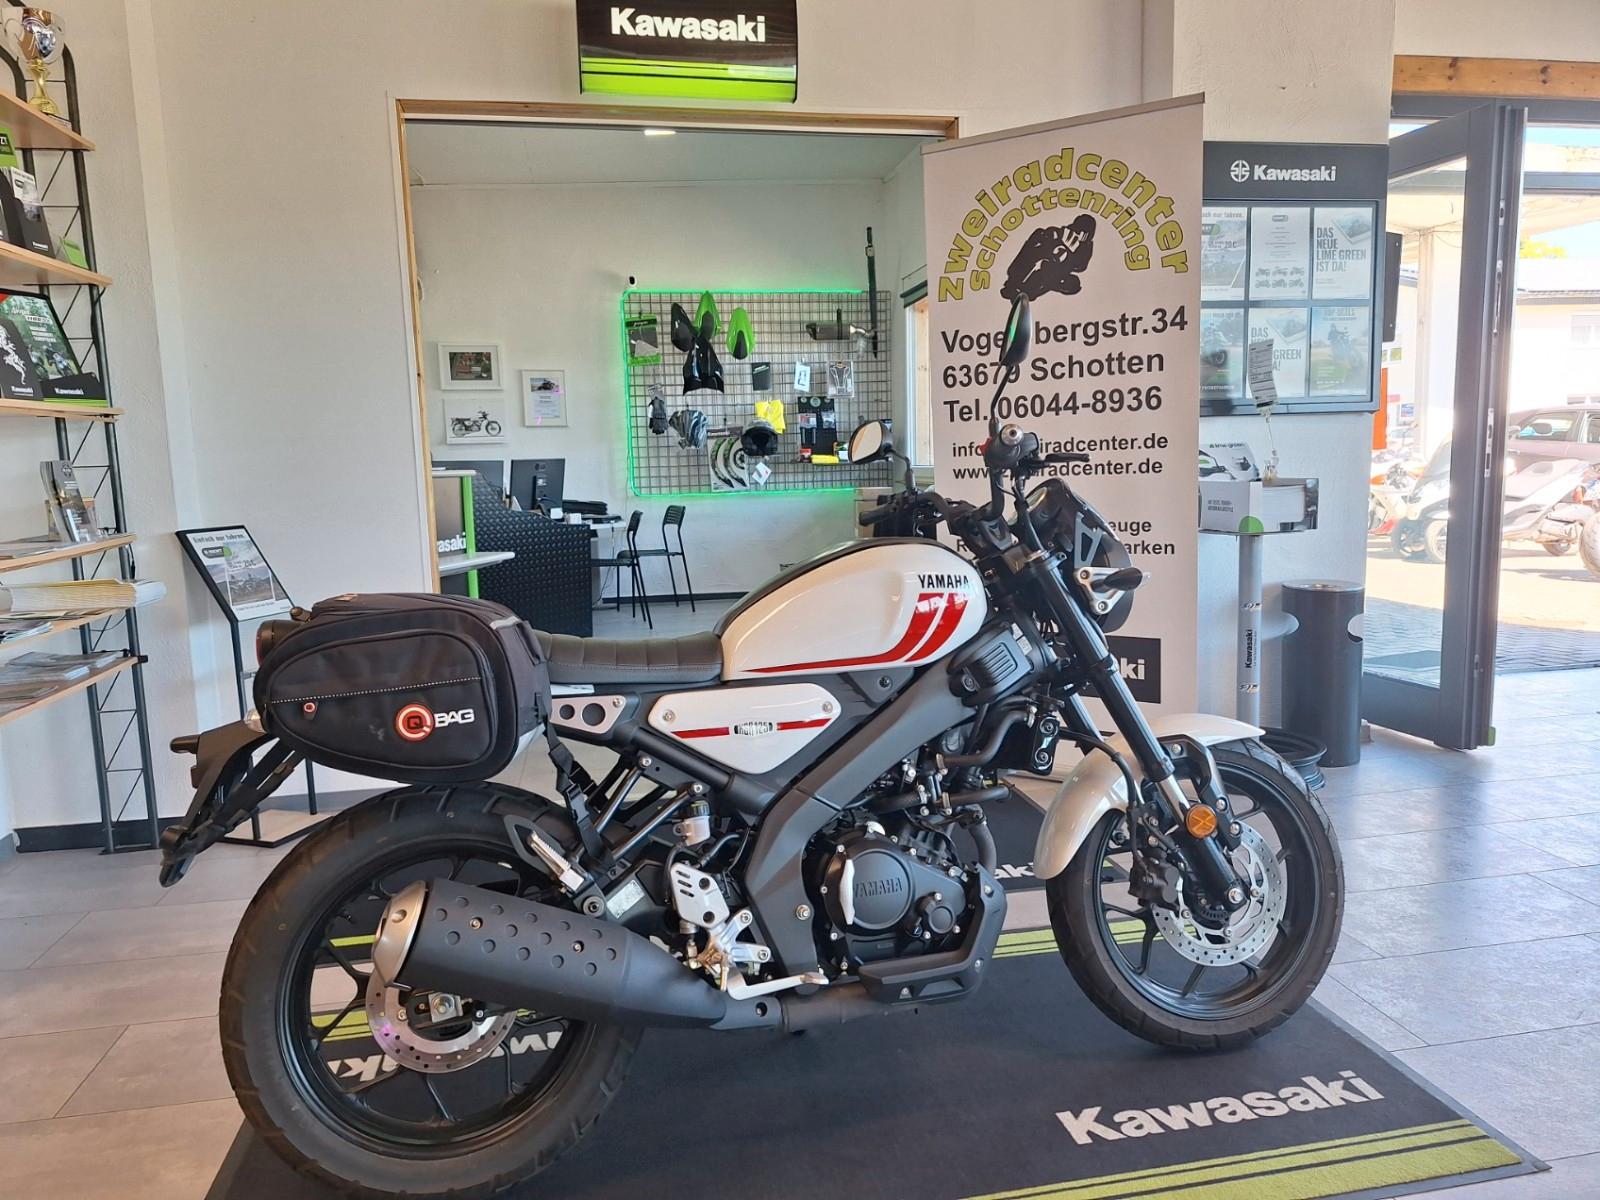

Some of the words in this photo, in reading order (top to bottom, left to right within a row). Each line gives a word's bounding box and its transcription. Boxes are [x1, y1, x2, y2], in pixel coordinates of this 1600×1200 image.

[610, 7, 766, 43] Kawasaki
[1253, 164, 1337, 182] Kawasaki
[1316, 227, 1334, 239] DAS
[1316, 238, 1338, 250] NEUE
[1316, 249, 1337, 261] LIME
[1338, 249, 1367, 260] GREEN
[1316, 261, 1329, 272] IST
[941, 305, 1188, 357] Vogebergstr.34
[1251, 327, 1269, 338] DAS
[1030, 352, 1165, 382] Schotten
[943, 398, 989, 422] Tel.
[999, 386, 1163, 420] 06044-8936
[1125, 541, 1175, 555] arken
[917, 574, 969, 589] YAMAHA
[1054, 1070, 1385, 1145] Kawasaki
